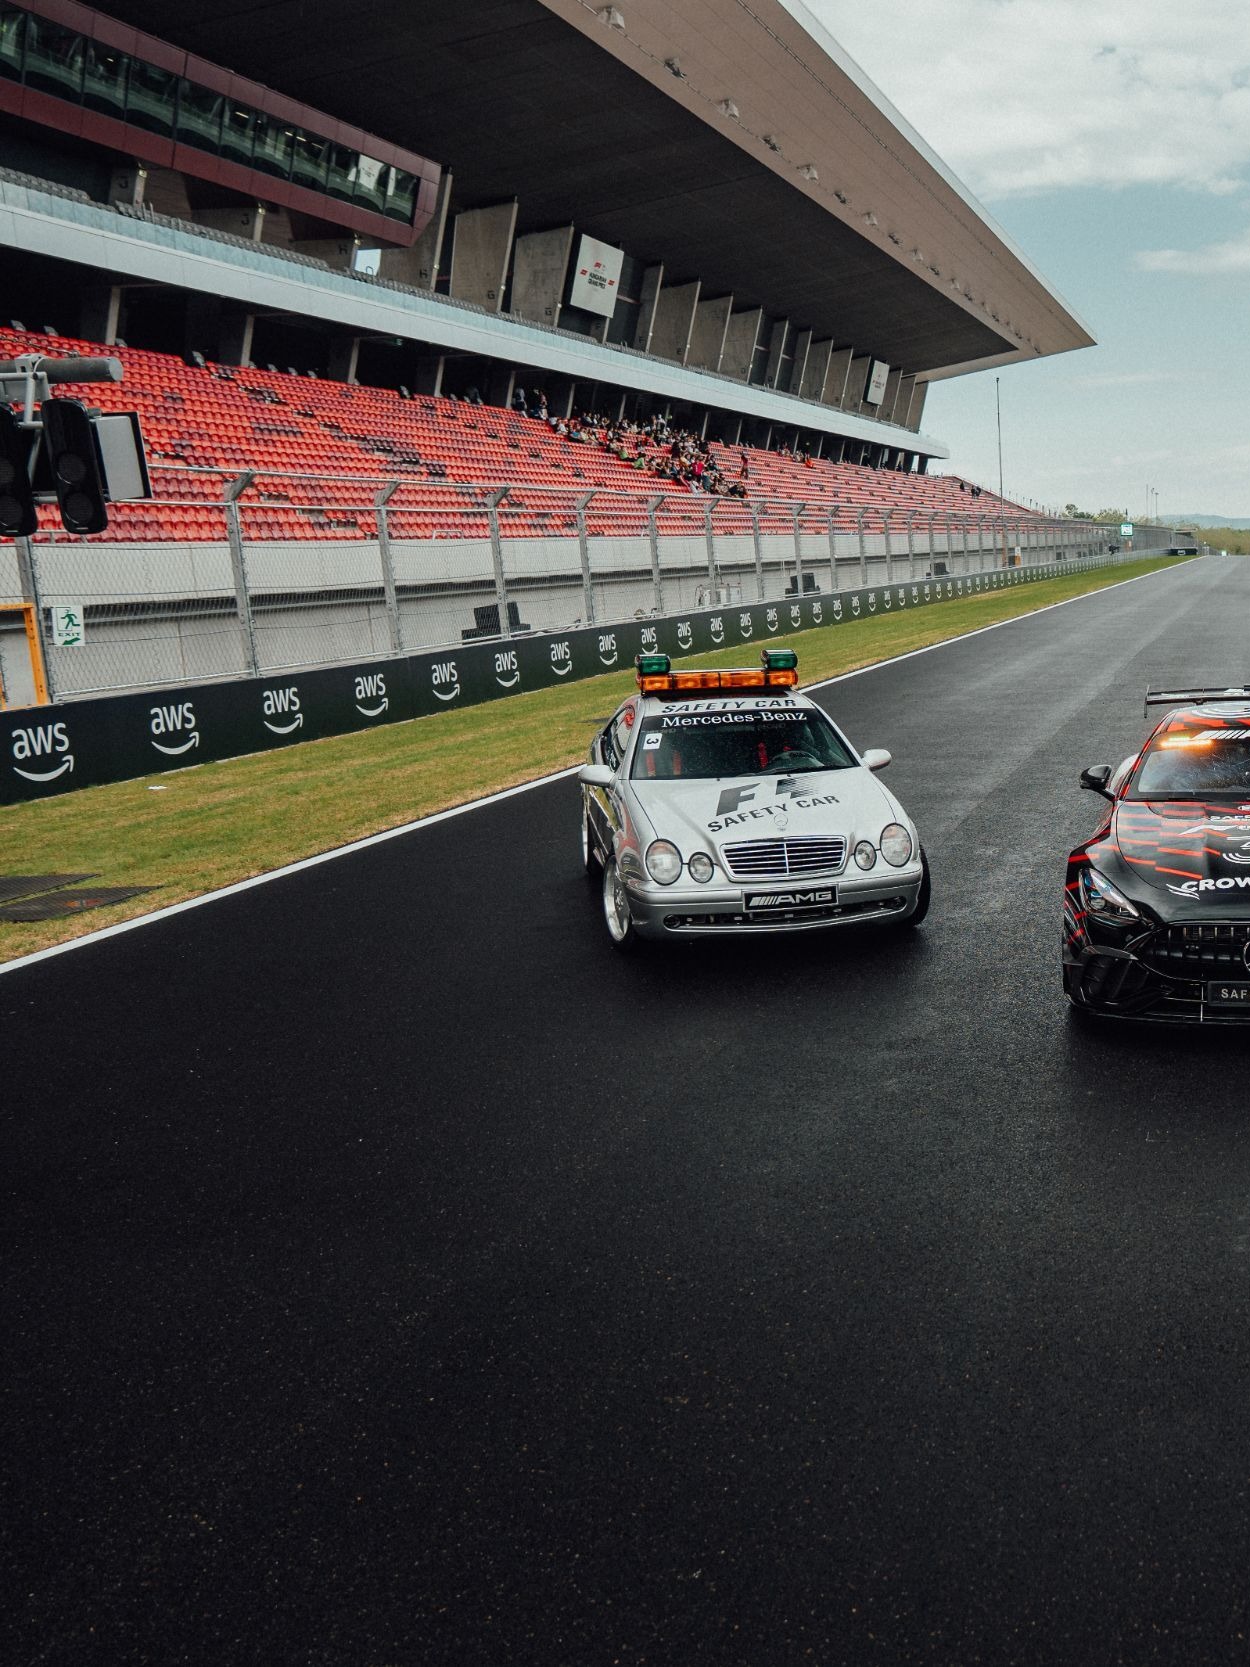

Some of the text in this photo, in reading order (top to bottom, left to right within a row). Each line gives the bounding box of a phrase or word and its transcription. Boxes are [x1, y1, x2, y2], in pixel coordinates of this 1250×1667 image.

[641, 626, 656, 644] aws
[677, 621, 692, 637] aws
[710, 617, 723, 632] aws
[551, 641, 570, 662] aws
[599, 633, 616, 652] aws
[494, 650, 518, 672] aws
[431, 661, 458, 685] aws
[355, 673, 387, 700] aws
[263, 686, 301, 716] aws
[661, 699, 797, 714] SAFETY CAR
[150, 702, 196, 735] aws
[661, 711, 807, 728] Mercedes-Benz
[12, 722, 70, 760] aws
[708, 795, 841, 833] SAFETY CAR
[777, 889, 832, 904] AMG
